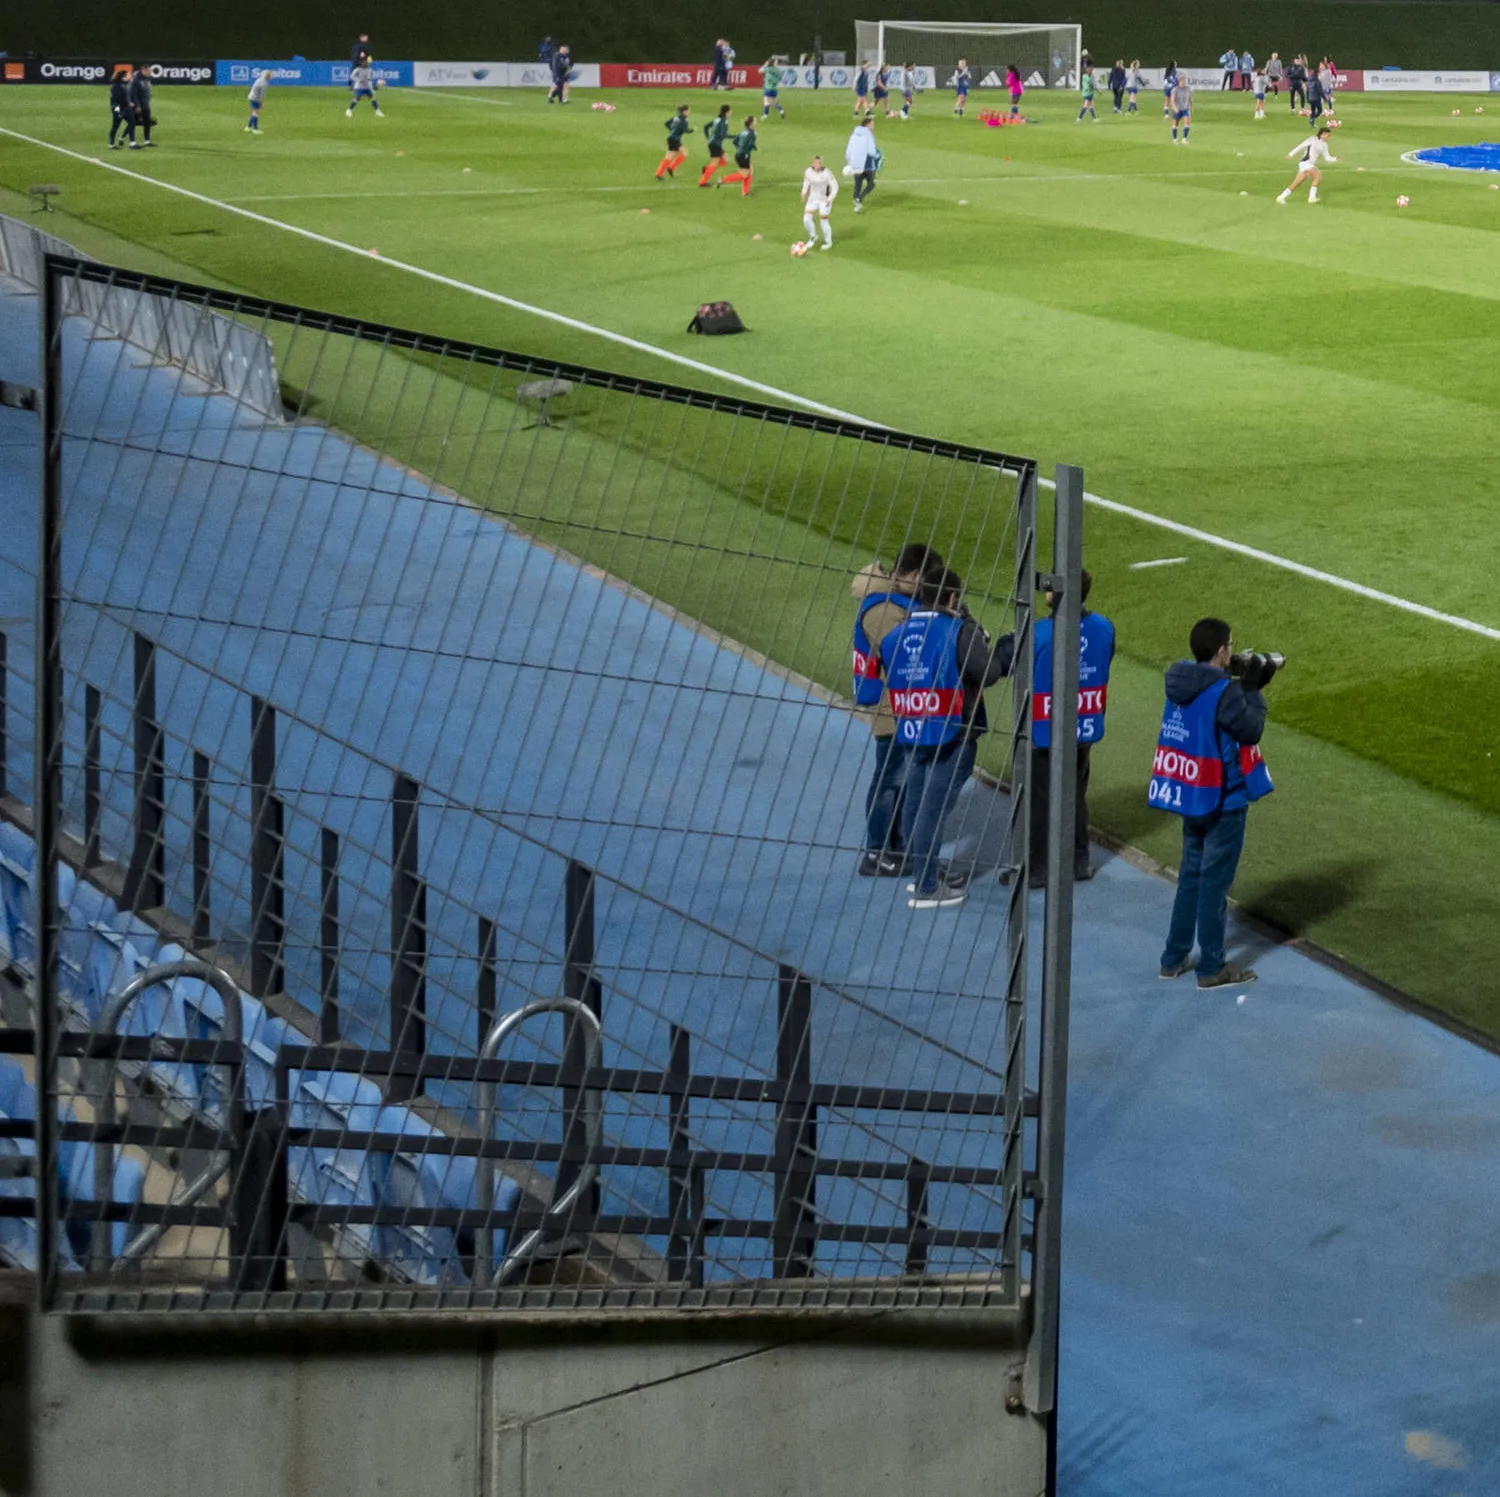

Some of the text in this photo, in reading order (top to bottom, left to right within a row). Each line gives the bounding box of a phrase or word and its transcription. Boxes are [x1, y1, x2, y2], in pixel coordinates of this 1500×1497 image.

[41, 63, 105, 80] Orange
[150, 64, 212, 80] Orange
[627, 70, 692, 84] Emirates
[1148, 778, 1182, 807] 041
